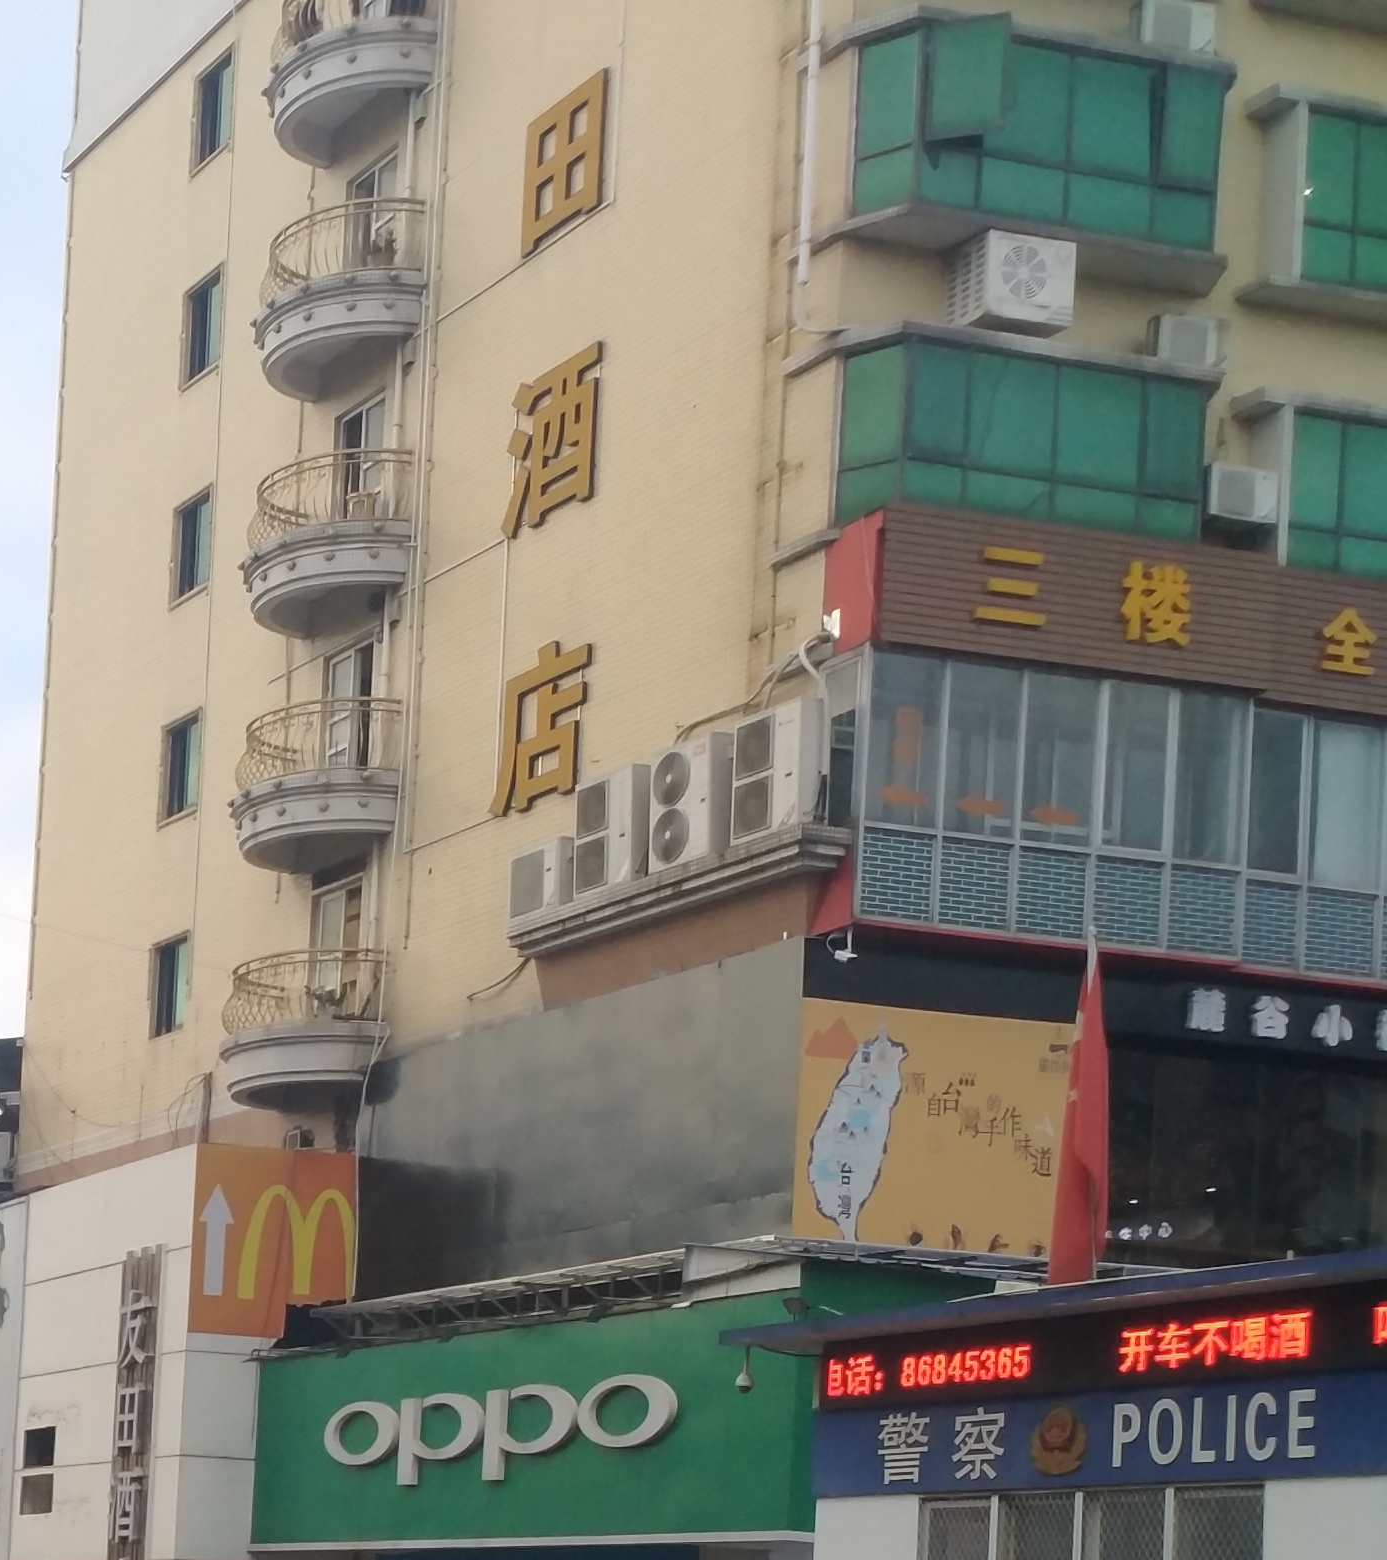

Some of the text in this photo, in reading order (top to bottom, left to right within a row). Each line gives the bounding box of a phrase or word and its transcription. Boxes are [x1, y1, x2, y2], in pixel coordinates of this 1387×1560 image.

[1119, 1311, 1313, 1373] 开车不喝酒
[877, 1389, 1317, 1486] 警察 POLICE
